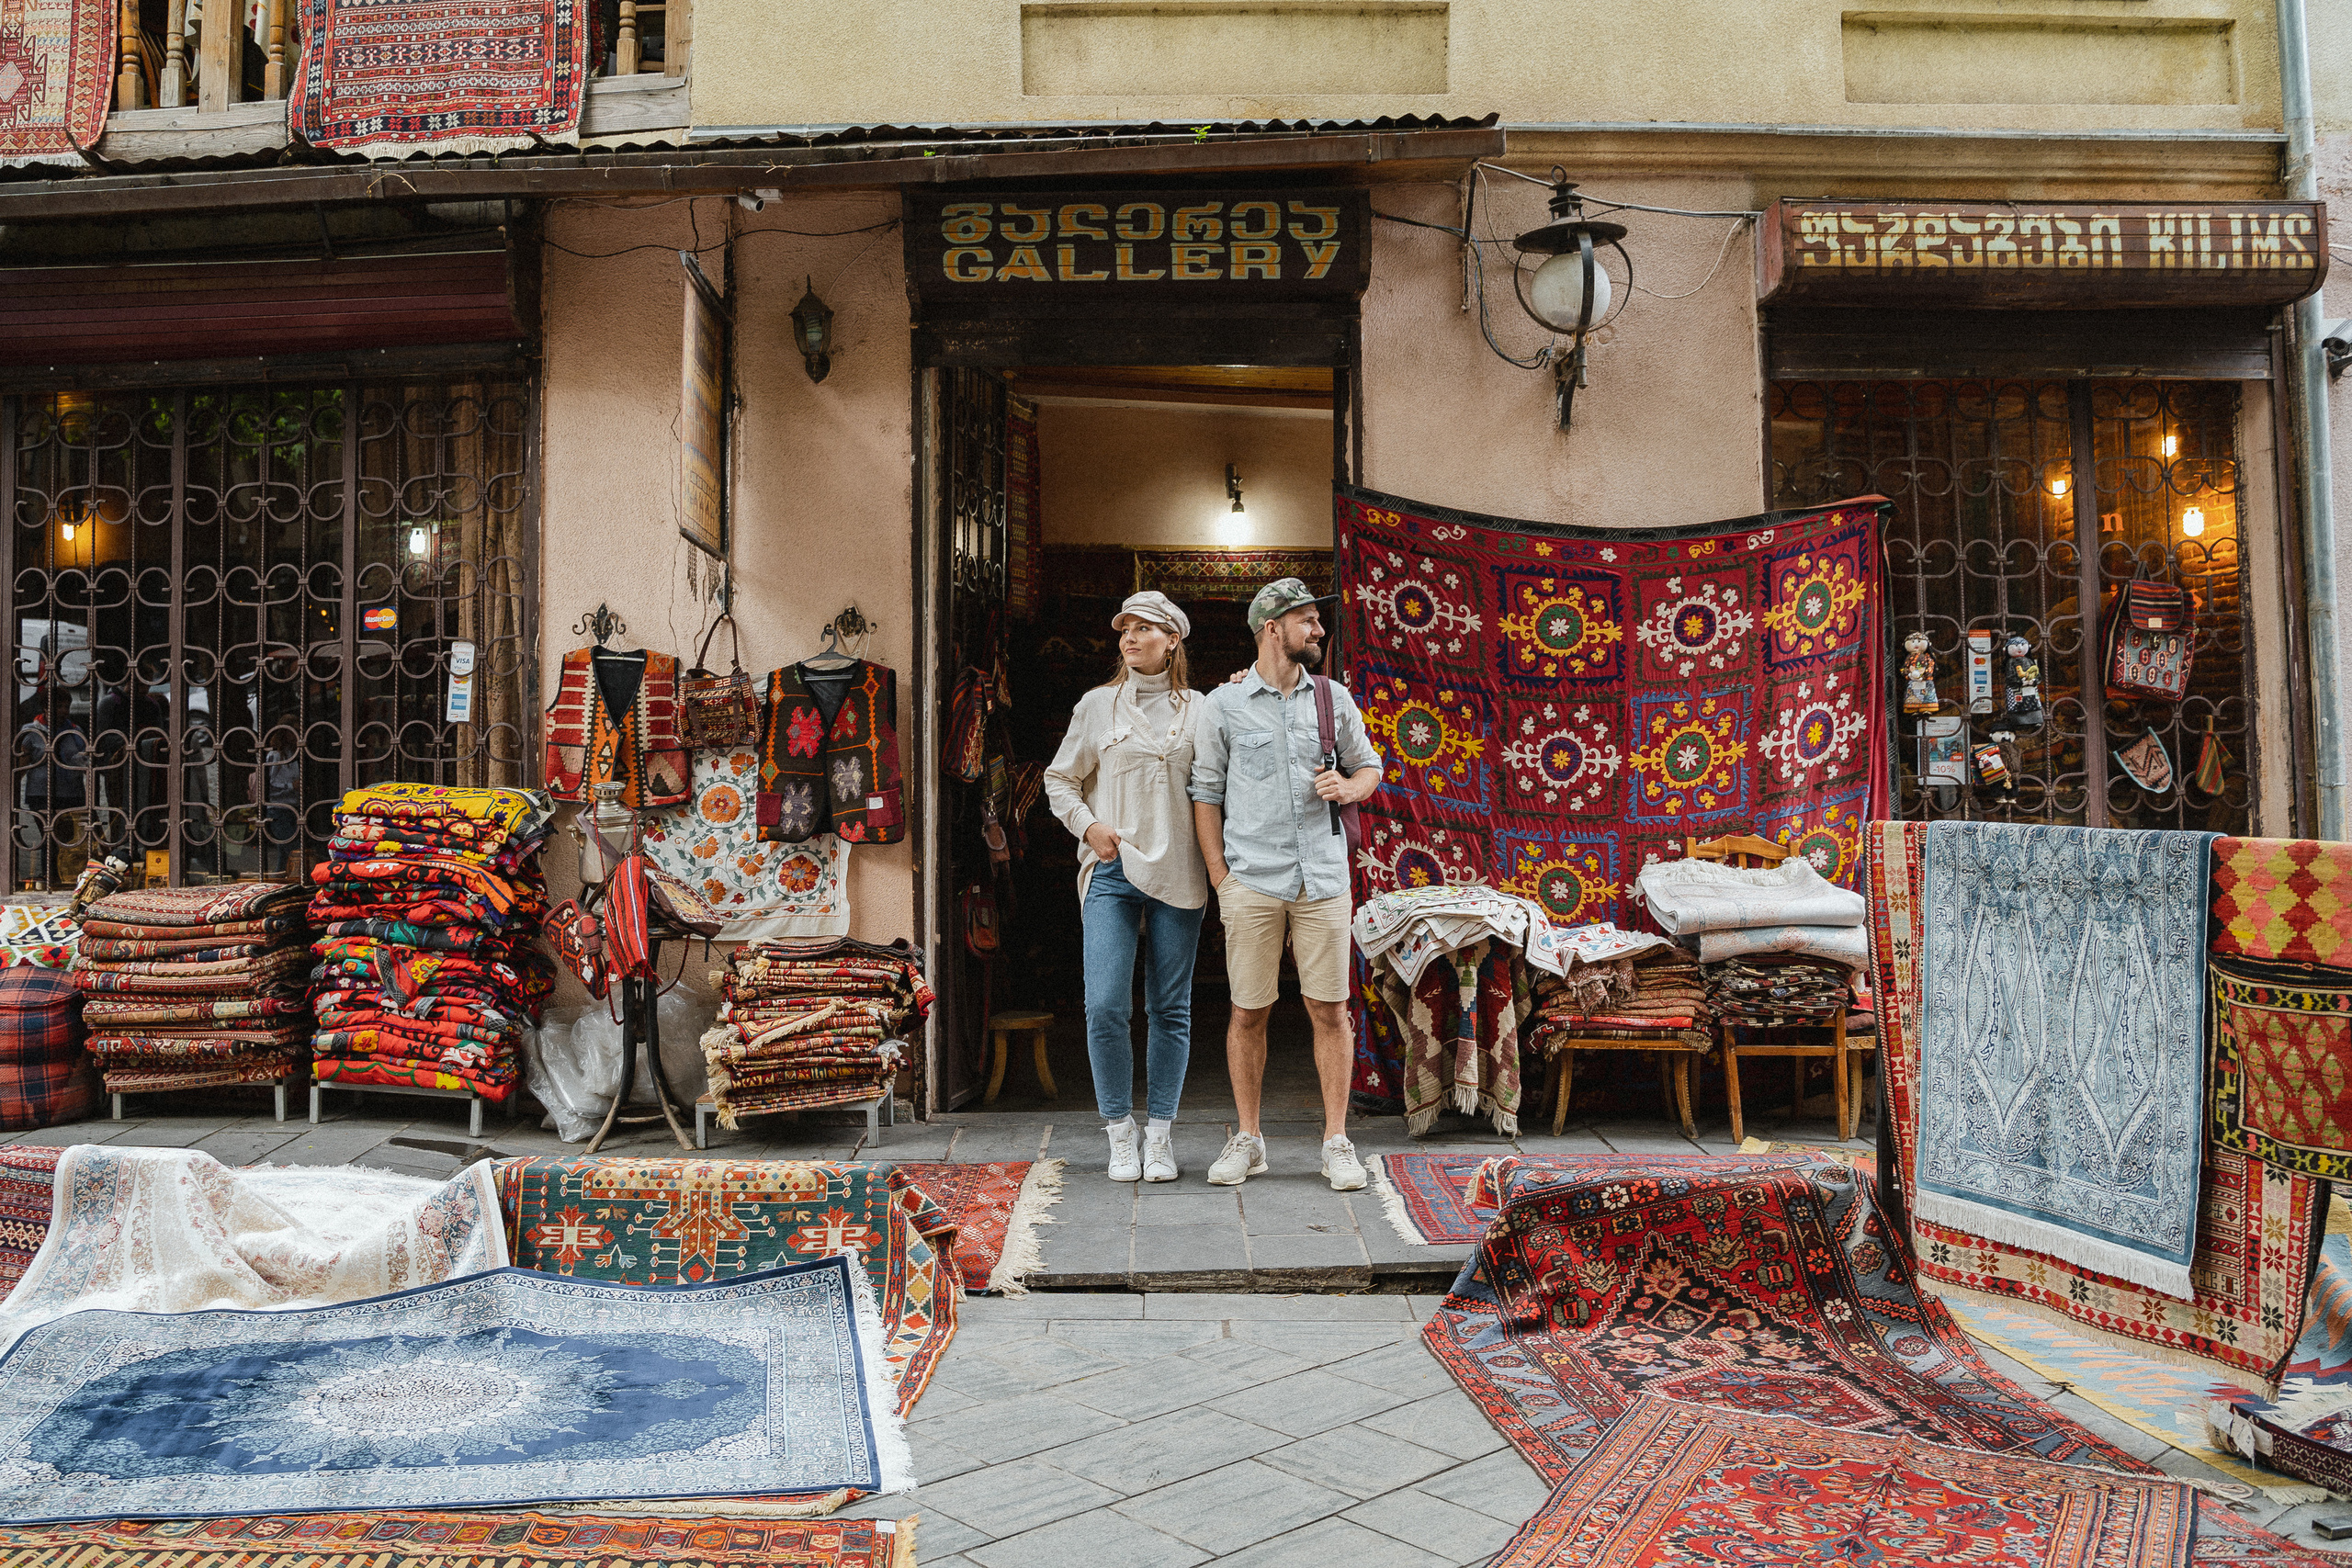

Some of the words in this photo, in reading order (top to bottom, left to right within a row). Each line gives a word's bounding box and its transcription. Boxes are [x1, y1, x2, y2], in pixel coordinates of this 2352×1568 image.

[941, 201, 1340, 243] გალერეა
[1801, 211, 2122, 273] ფარდაგები
[2147, 212, 2314, 272] KILIMS
[943, 241, 1341, 282] GALLERY
[365, 615, 395, 624] MasterCard
[1932, 765, 1956, 773] -10%
